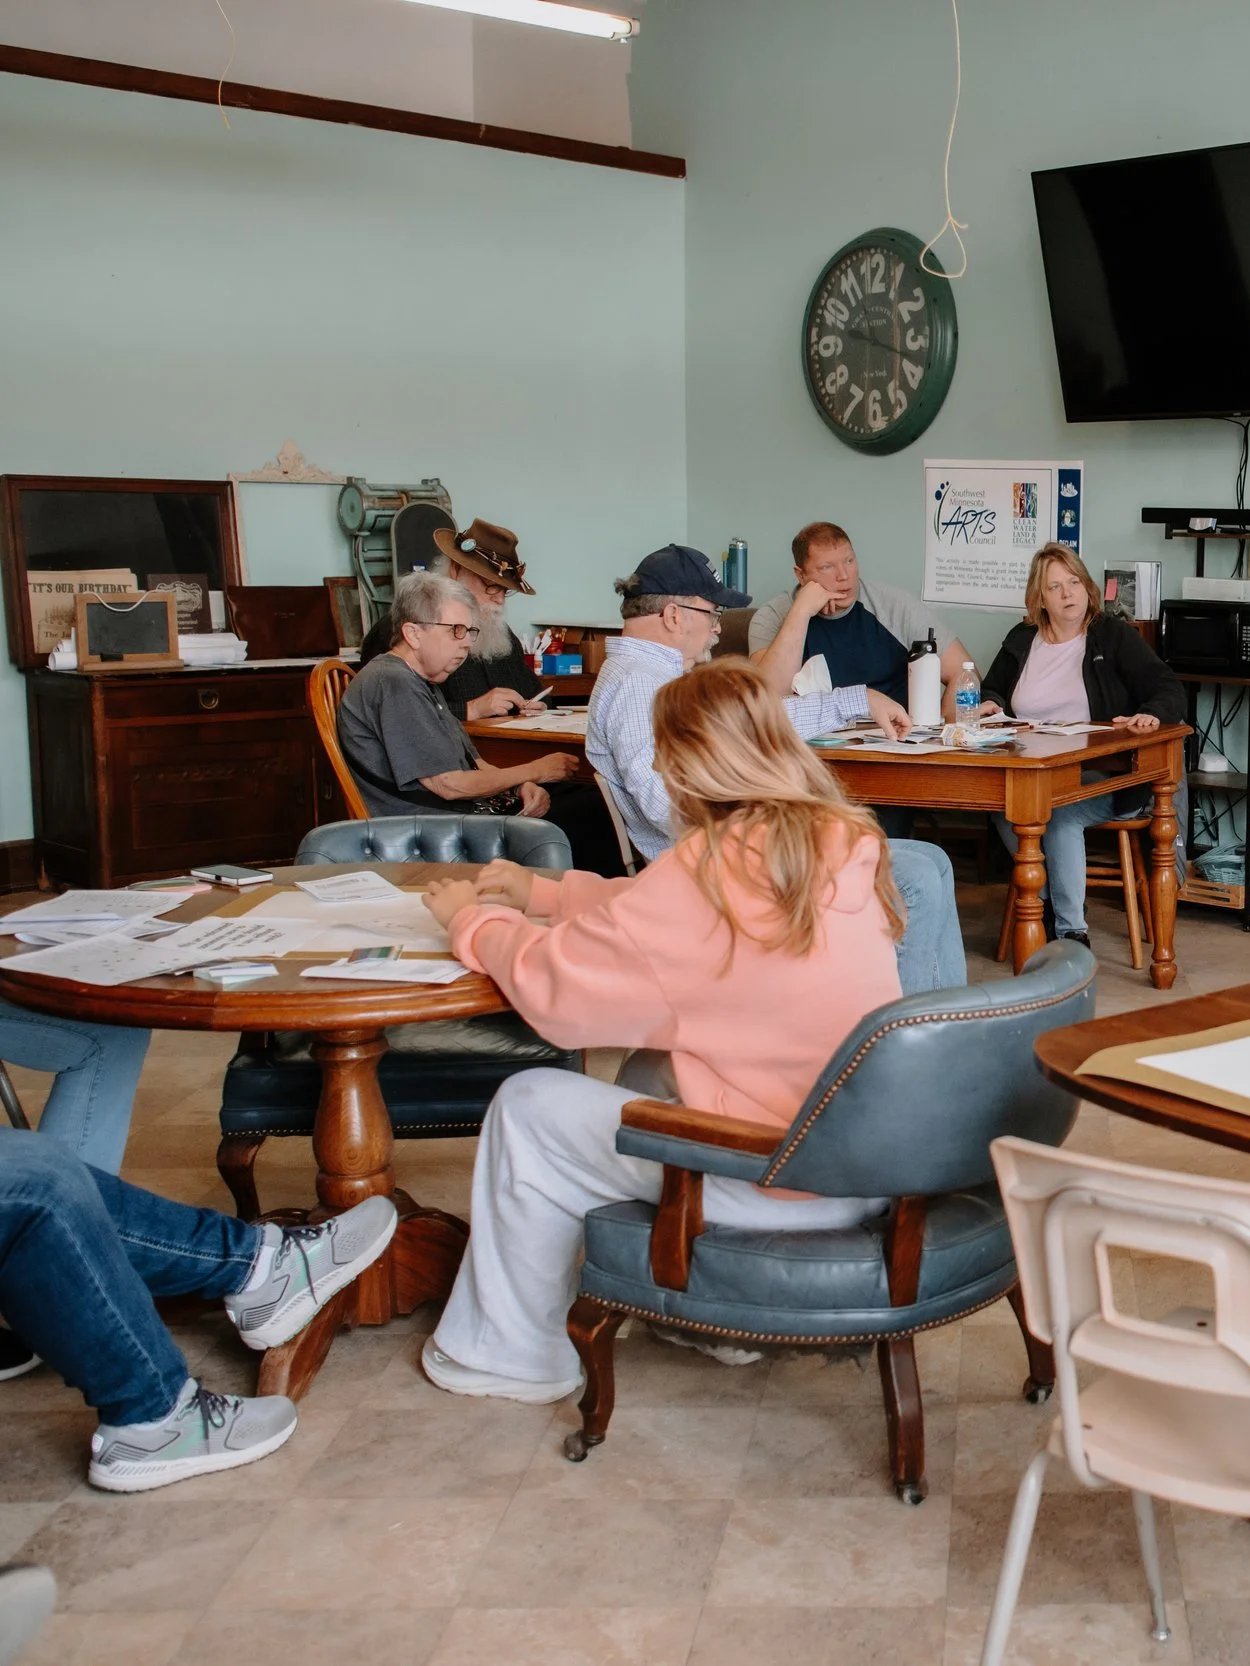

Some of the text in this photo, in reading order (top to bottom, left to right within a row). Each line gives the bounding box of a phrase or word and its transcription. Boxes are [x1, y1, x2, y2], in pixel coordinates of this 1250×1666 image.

[840, 268, 864, 307] 11
[860, 253, 886, 294] 12
[888, 262, 905, 300] 1
[823, 298, 849, 330] 10
[899, 287, 925, 323] 2
[818, 335, 843, 358] 9
[905, 327, 929, 351] 3
[825, 364, 848, 394] 8
[902, 359, 924, 390] 4
[843, 384, 864, 423] 7
[867, 390, 888, 430] 6
[887, 381, 908, 421] 5
[949, 499, 985, 507] Minnesota
[950, 489, 986, 498] Southwest
[942, 506, 997, 546] ARTS
[968, 536, 996, 545] Council
[55, 584, 74, 593] OUR
[45, 631, 59, 639] The
